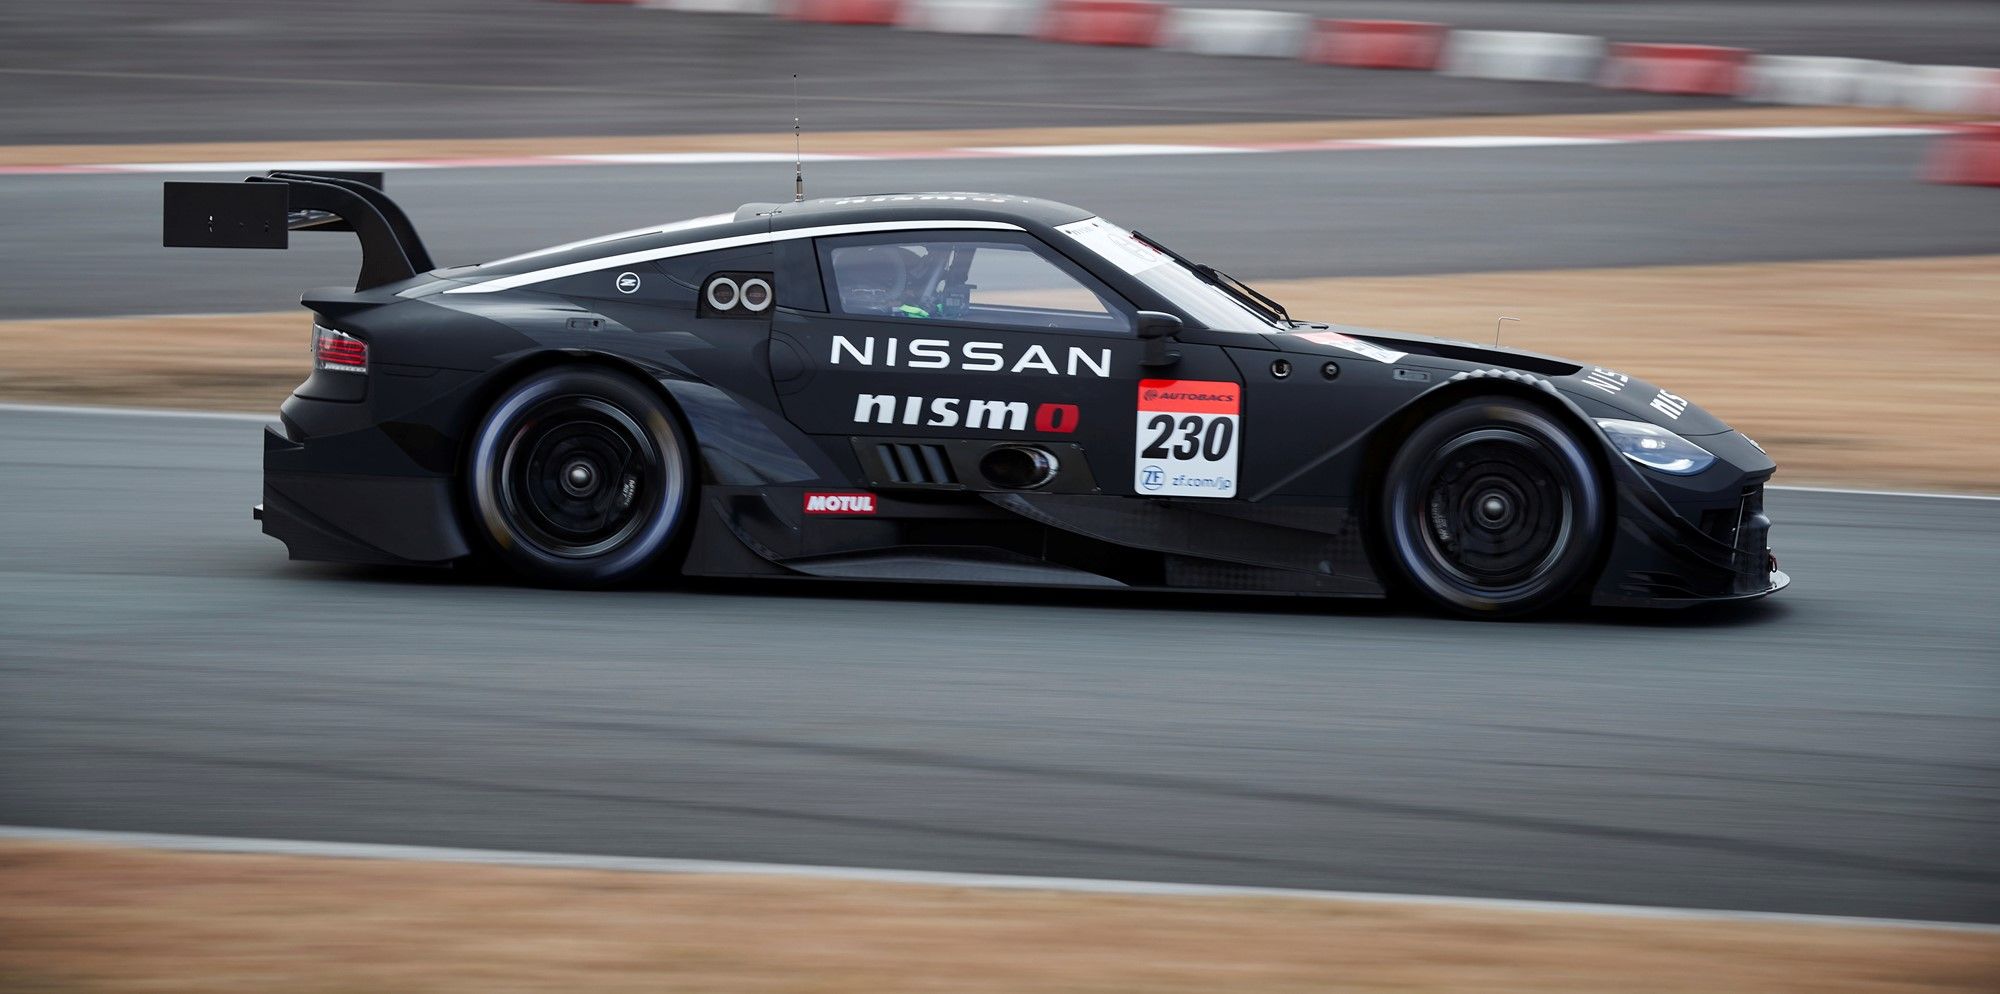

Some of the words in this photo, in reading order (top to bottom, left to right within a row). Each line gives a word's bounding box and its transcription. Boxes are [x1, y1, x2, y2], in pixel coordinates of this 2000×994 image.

[830, 335, 1112, 378] NISSAN
[1160, 392, 1235, 402] AUTOBACS
[1141, 414, 1234, 462] 230
[1172, 475, 1232, 490] zf.com/jp
[806, 495, 874, 512] MOTUL
